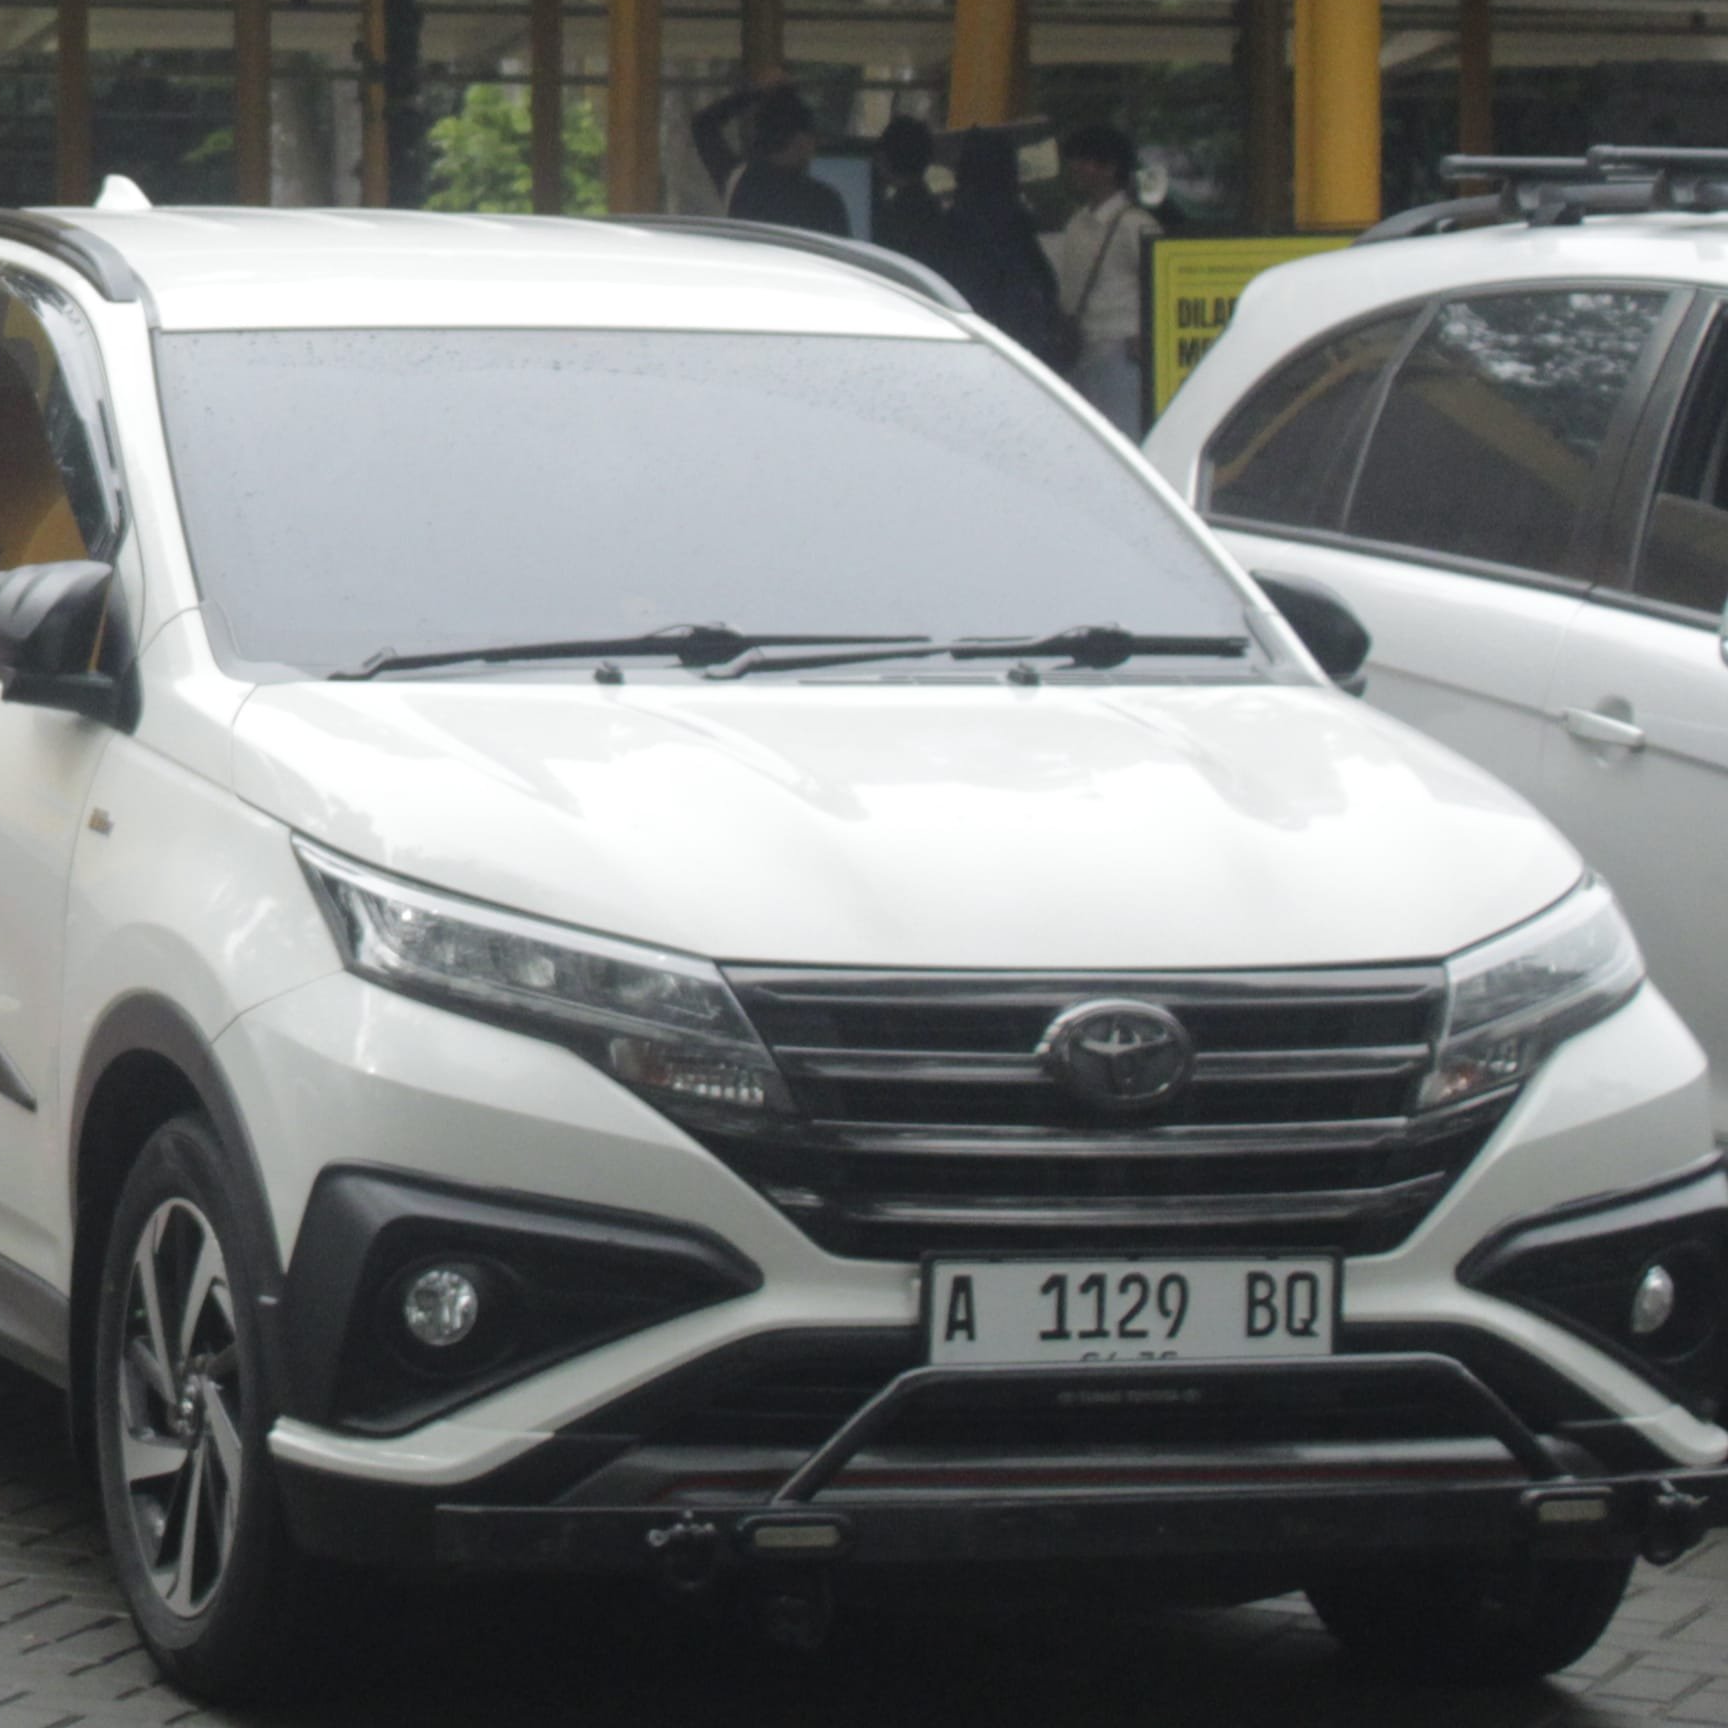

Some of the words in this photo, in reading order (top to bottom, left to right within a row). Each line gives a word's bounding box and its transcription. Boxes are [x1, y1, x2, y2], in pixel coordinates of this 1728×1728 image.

[943, 1275, 977, 1343] A
[1038, 1272, 1190, 1342] 1129
[1244, 1270, 1321, 1340] BQ
